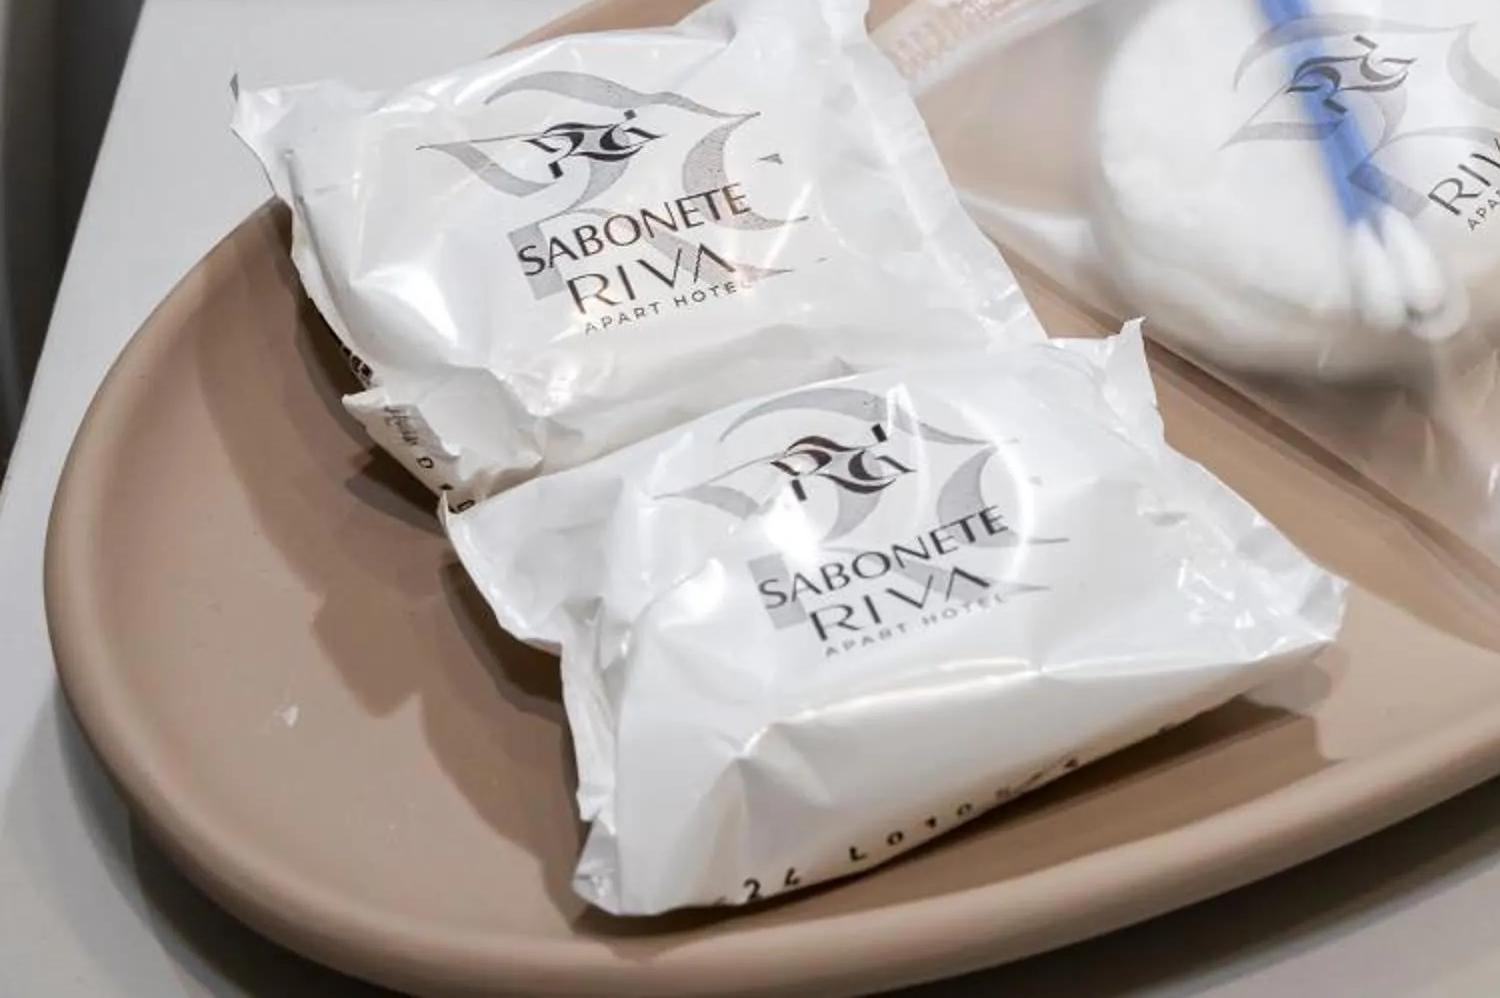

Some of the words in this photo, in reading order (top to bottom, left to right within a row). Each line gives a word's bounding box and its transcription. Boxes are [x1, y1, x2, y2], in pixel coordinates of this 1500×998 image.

[516, 182, 753, 277] SABONETE
[566, 242, 737, 315] RIVA
[585, 302, 661, 335] APART
[757, 505, 1011, 610] SABONETE
[809, 566, 991, 642] RIVA
[825, 622, 906, 658] APART
[921, 593, 1006, 626] HOTEL
